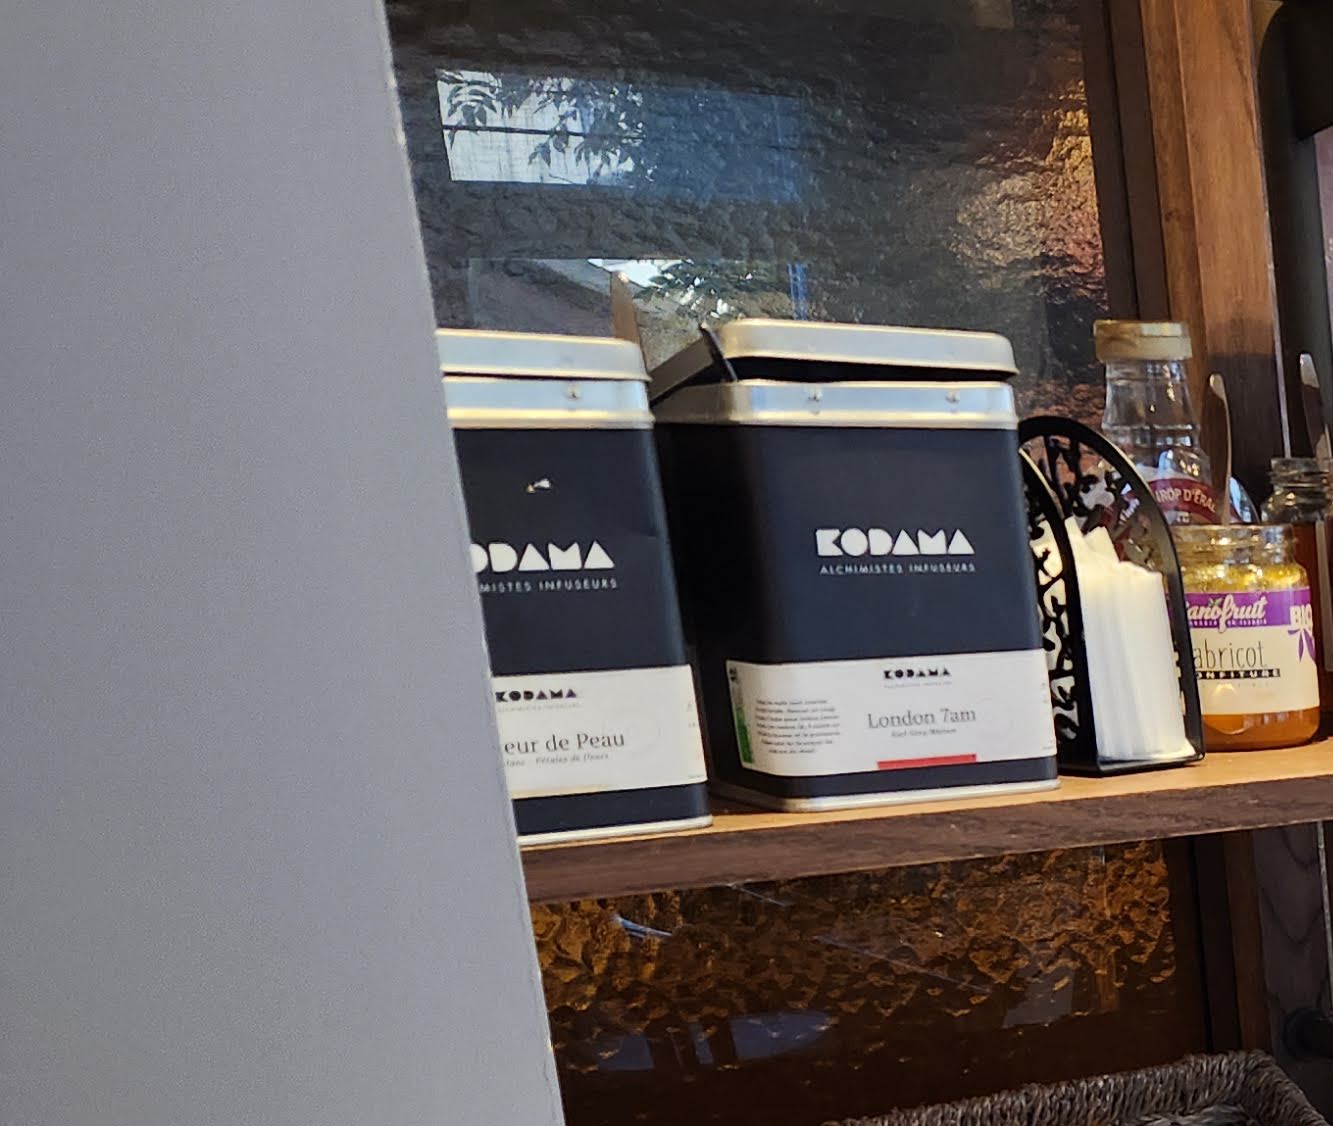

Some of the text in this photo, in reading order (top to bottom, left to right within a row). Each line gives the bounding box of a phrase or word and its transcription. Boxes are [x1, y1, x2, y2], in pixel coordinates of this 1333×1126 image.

[1154, 488, 1181, 503] IROP
[816, 528, 975, 556] KODAMA
[470, 541, 615, 573] ODAMA
[820, 562, 976, 575] ALCHIMISTES INFUSEURS
[479, 577, 618, 594] MISTES INFUSEURS
[1193, 639, 1267, 669] abricot
[883, 667, 951, 680] KODAMA
[1196, 668, 1280, 679] ONFITURE
[495, 688, 577, 703] KODAMA
[867, 707, 977, 729] London 7am
[504, 732, 625, 756] eur de Peau
